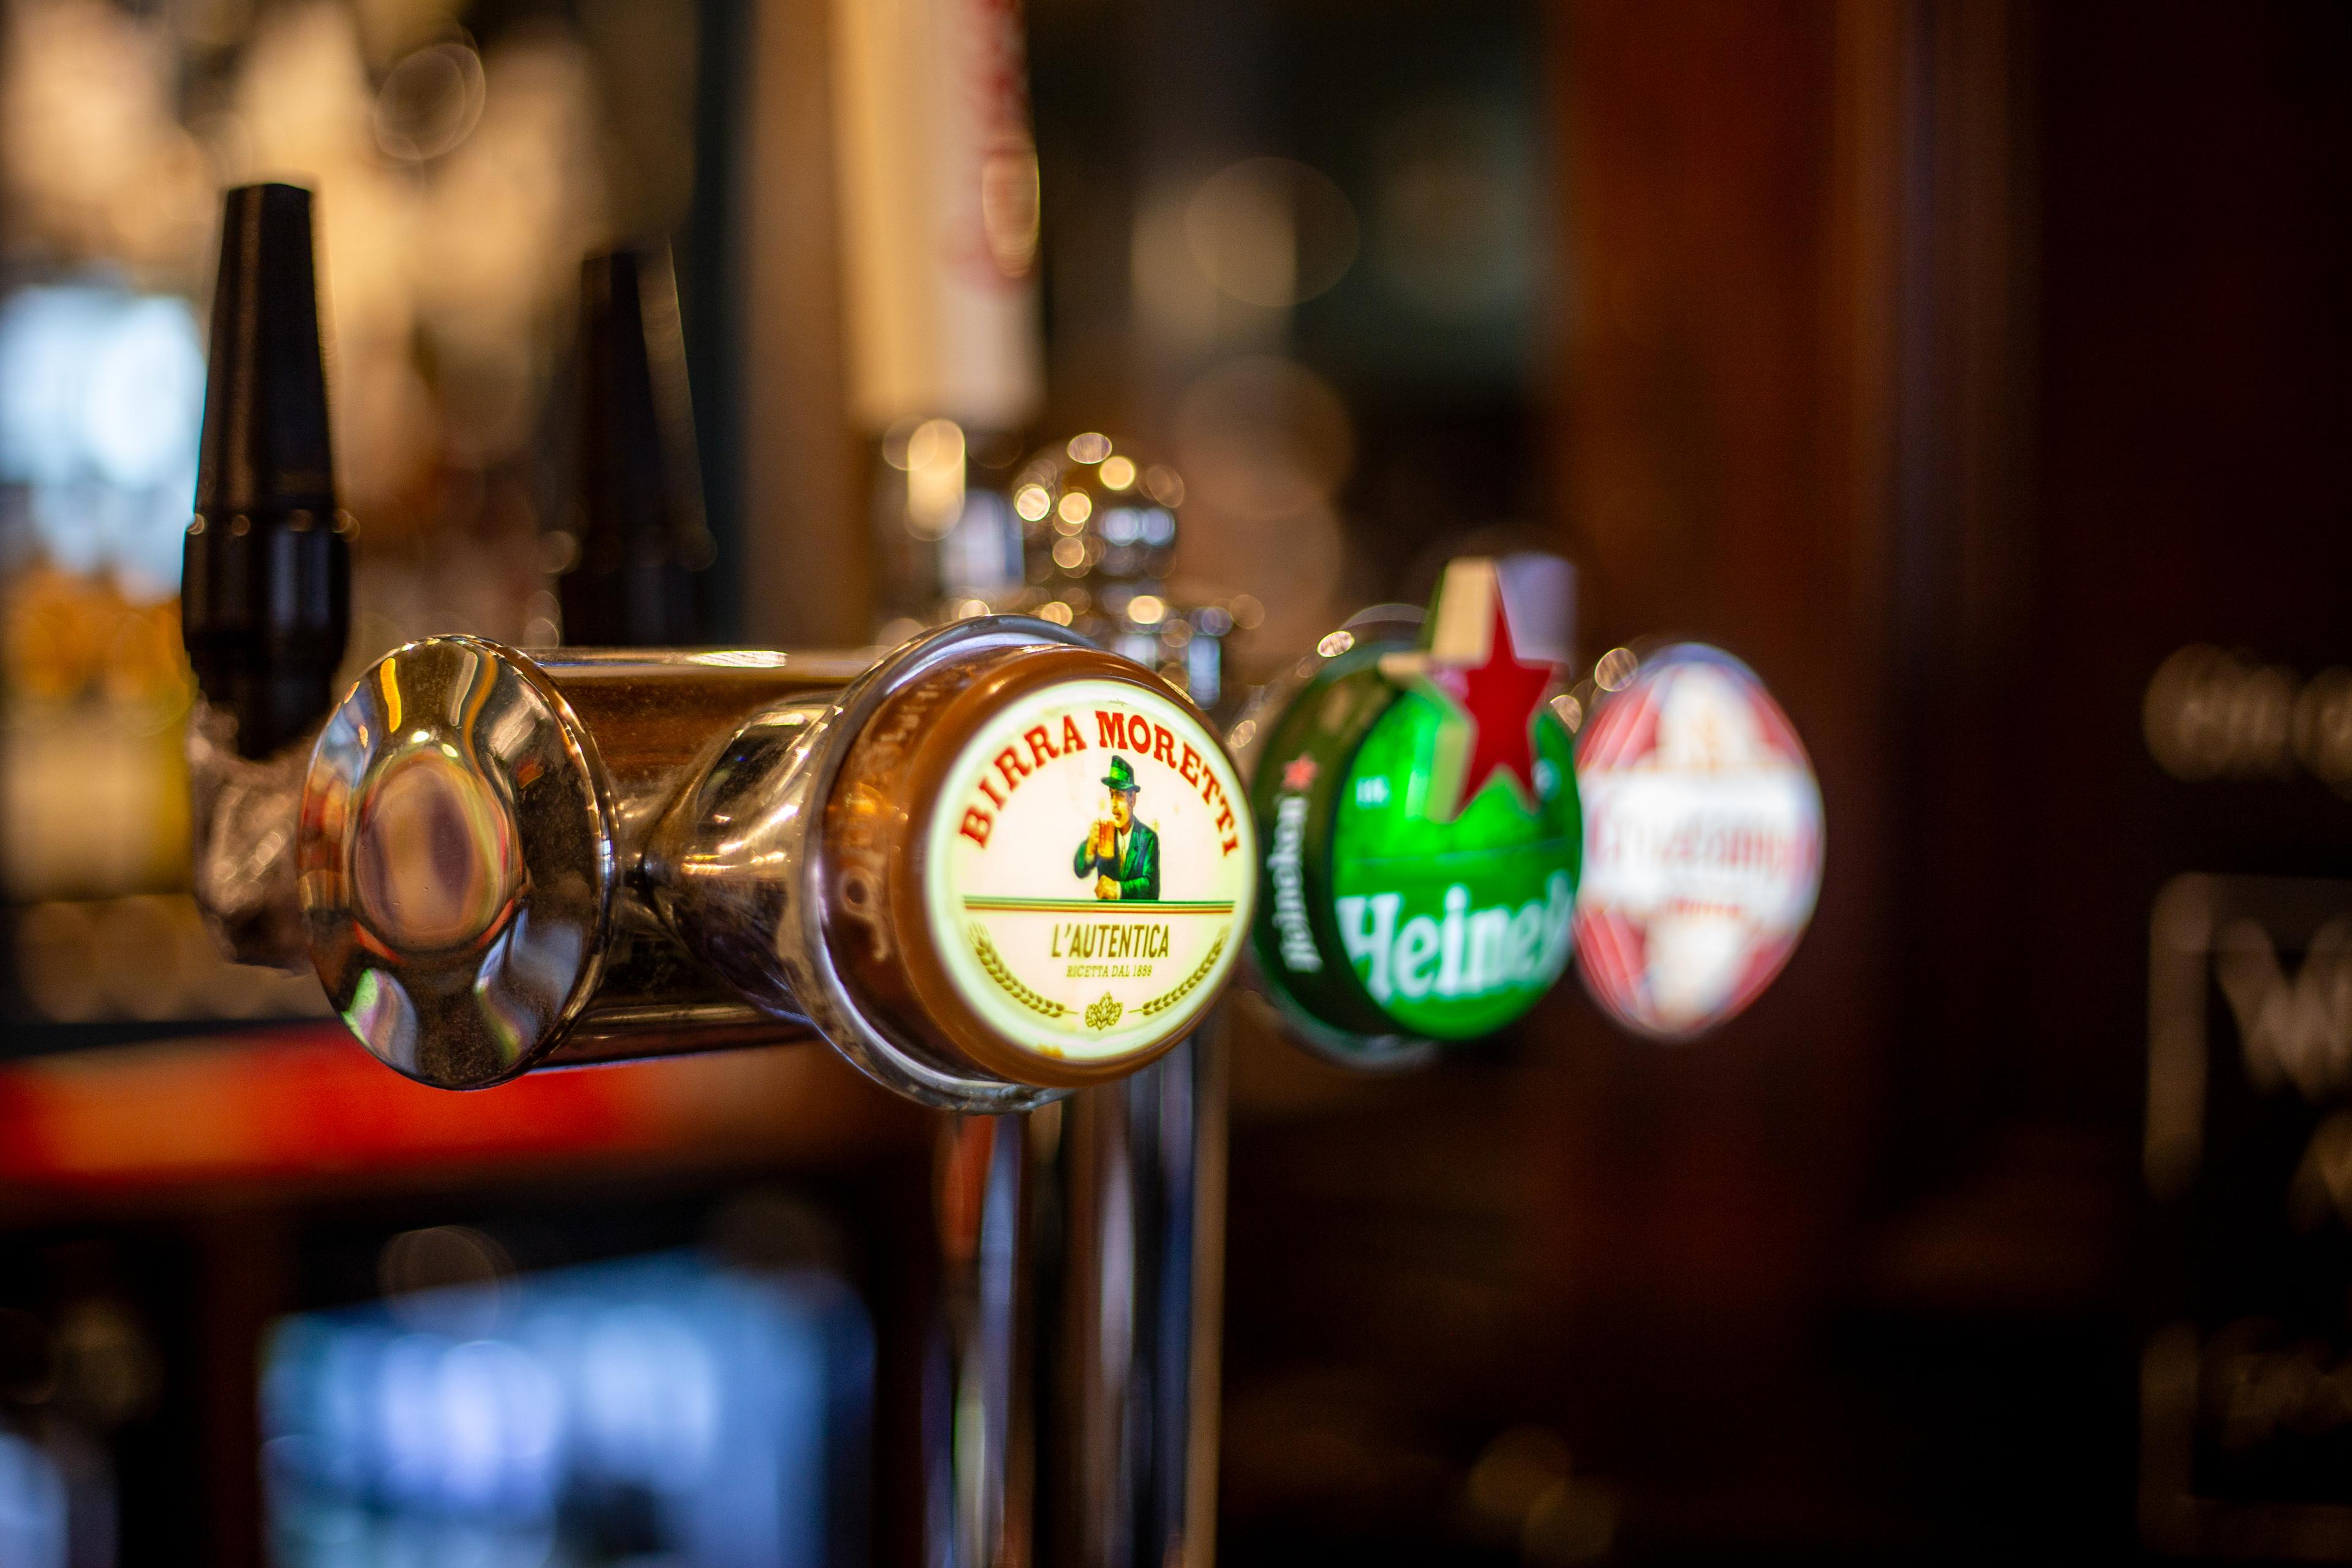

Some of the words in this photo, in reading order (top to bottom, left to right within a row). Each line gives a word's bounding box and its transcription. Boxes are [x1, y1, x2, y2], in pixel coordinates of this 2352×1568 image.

[960, 715, 1087, 849] BIRRA
[1095, 710, 1238, 858] MORETTI
[1051, 923, 1169, 958] L'AUTENTICA
[1066, 965, 1109, 978] RICETTA
[1111, 965, 1130, 978] DAL
